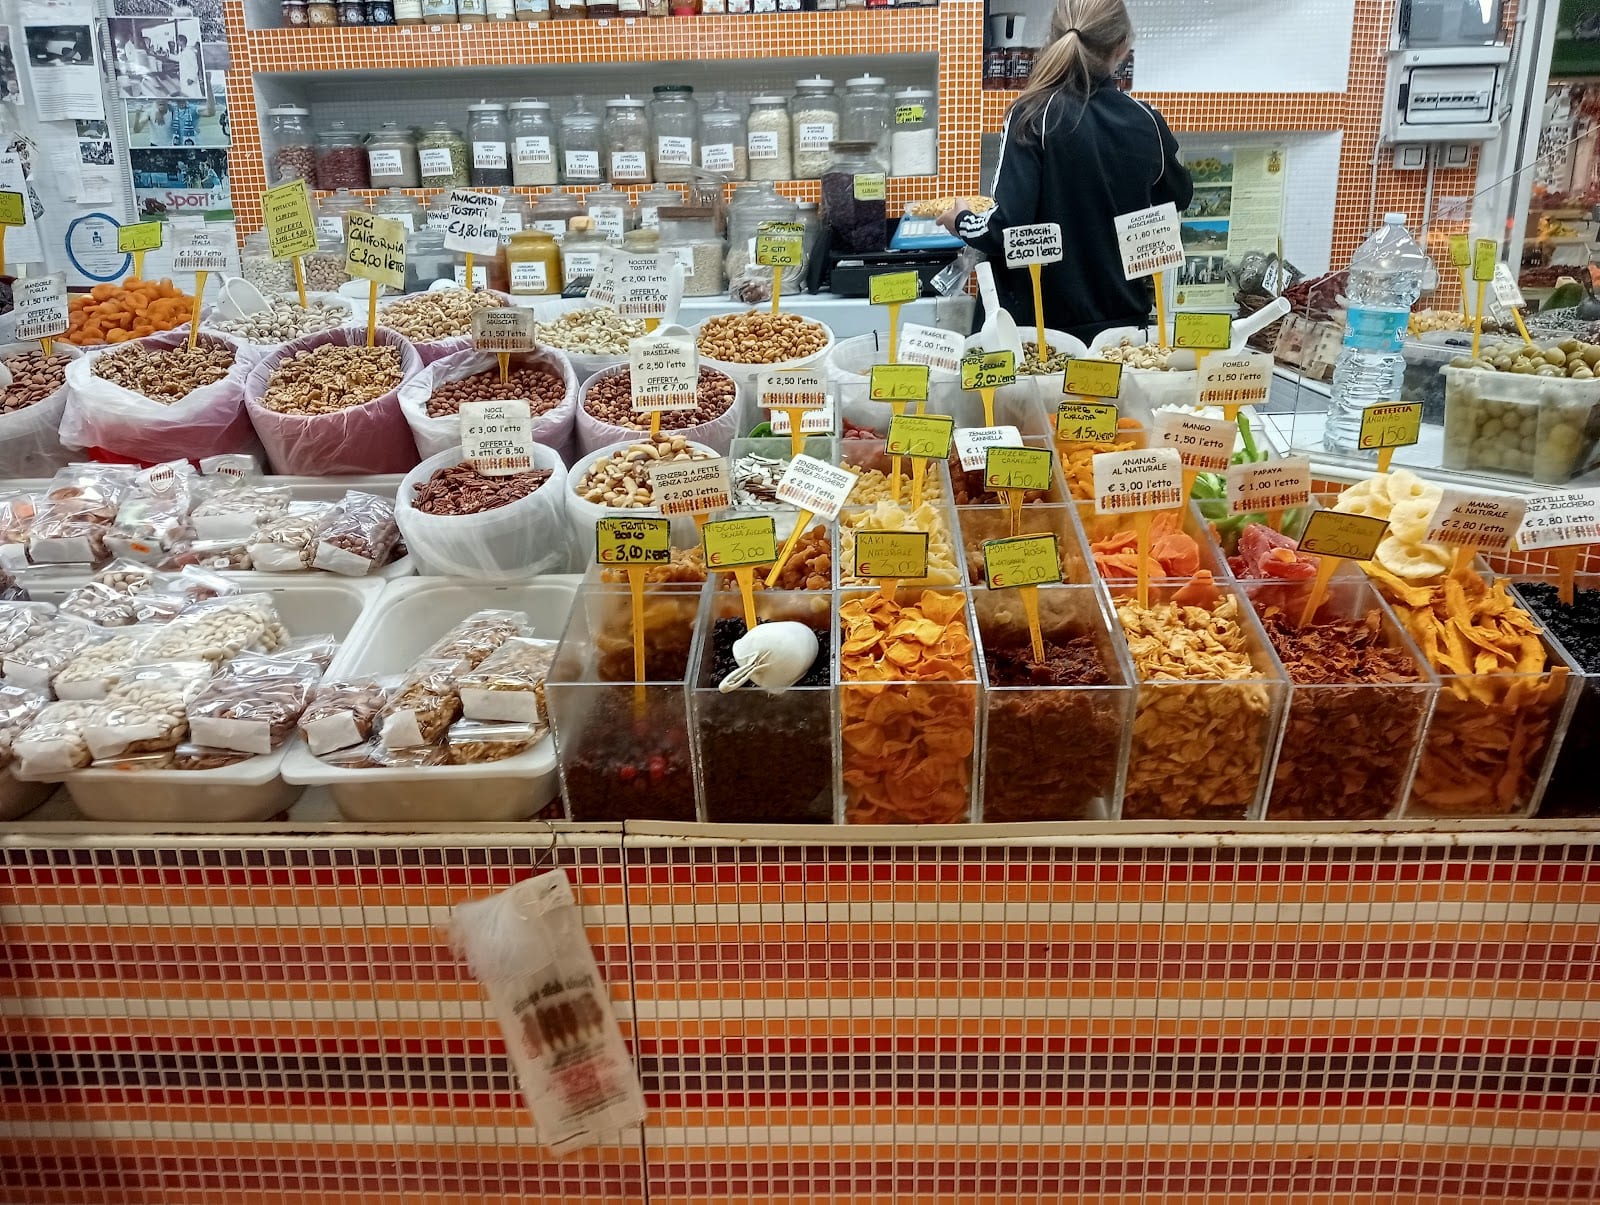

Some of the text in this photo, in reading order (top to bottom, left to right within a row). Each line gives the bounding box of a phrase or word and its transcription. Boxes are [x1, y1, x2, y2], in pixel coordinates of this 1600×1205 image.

[165, 191, 208, 209] Sport
[1130, 210, 1160, 223] CASTAGNE
[1152, 226, 1170, 236] l'etto
[1136, 240, 1165, 253] OFFERTA
[1160, 244, 1176, 254] 5,00
[29, 286, 48, 294] PUGLIA
[28, 308, 53, 318] OFFERTA
[488, 330, 505, 338] 1,50
[643, 348, 680, 356] BRASILIANE
[936, 342, 954, 352] l'etto
[646, 362, 663, 370] 2,50
[1217, 373, 1237, 382] 1,50
[1239, 372, 1261, 380] l'etto
[671, 383, 688, 391] 7,00
[1372, 406, 1412, 416] OFFERTA
[478, 426, 496, 434] 3,00
[1182, 422, 1210, 431] MANGO
[1060, 430, 1070, 438] €
[480, 440, 513, 448] OFFERTA
[1174, 434, 1195, 445] 1,50
[1199, 437, 1223, 448] l'etto
[505, 447, 524, 455] 8,50
[1122, 456, 1156, 466] ANANAS
[656, 469, 688, 481] ZENZERO
[698, 465, 719, 474] FETTE
[796, 459, 824, 472] ZENZERO
[831, 471, 848, 483] PEZZI
[1124, 463, 1167, 474] NATURALE
[1253, 467, 1282, 476] PAPAYA
[658, 472, 720, 488] SENZA ZUCCHERO
[794, 465, 845, 489] SENZA ZUCCHERO
[1108, 480, 1171, 492] € 3,00 l'etto
[1249, 480, 1270, 490] 1,00
[1274, 478, 1299, 487] l'etto
[673, 490, 694, 500] 2,00
[696, 486, 719, 496] l'etto
[797, 479, 814, 490] 2,00
[816, 484, 835, 500] l'etto
[1468, 501, 1499, 509] MANGO
[1549, 500, 1594, 510] ZUCCHERO
[1464, 508, 1508, 518] NATURALE
[1452, 520, 1476, 530] 2,80
[1479, 523, 1505, 532] l'etto
[1525, 515, 1594, 528] € 2,80 l'etto
[601, 544, 642, 562] € 3,00
[710, 552, 722, 564] €
[992, 574, 1004, 586] €
